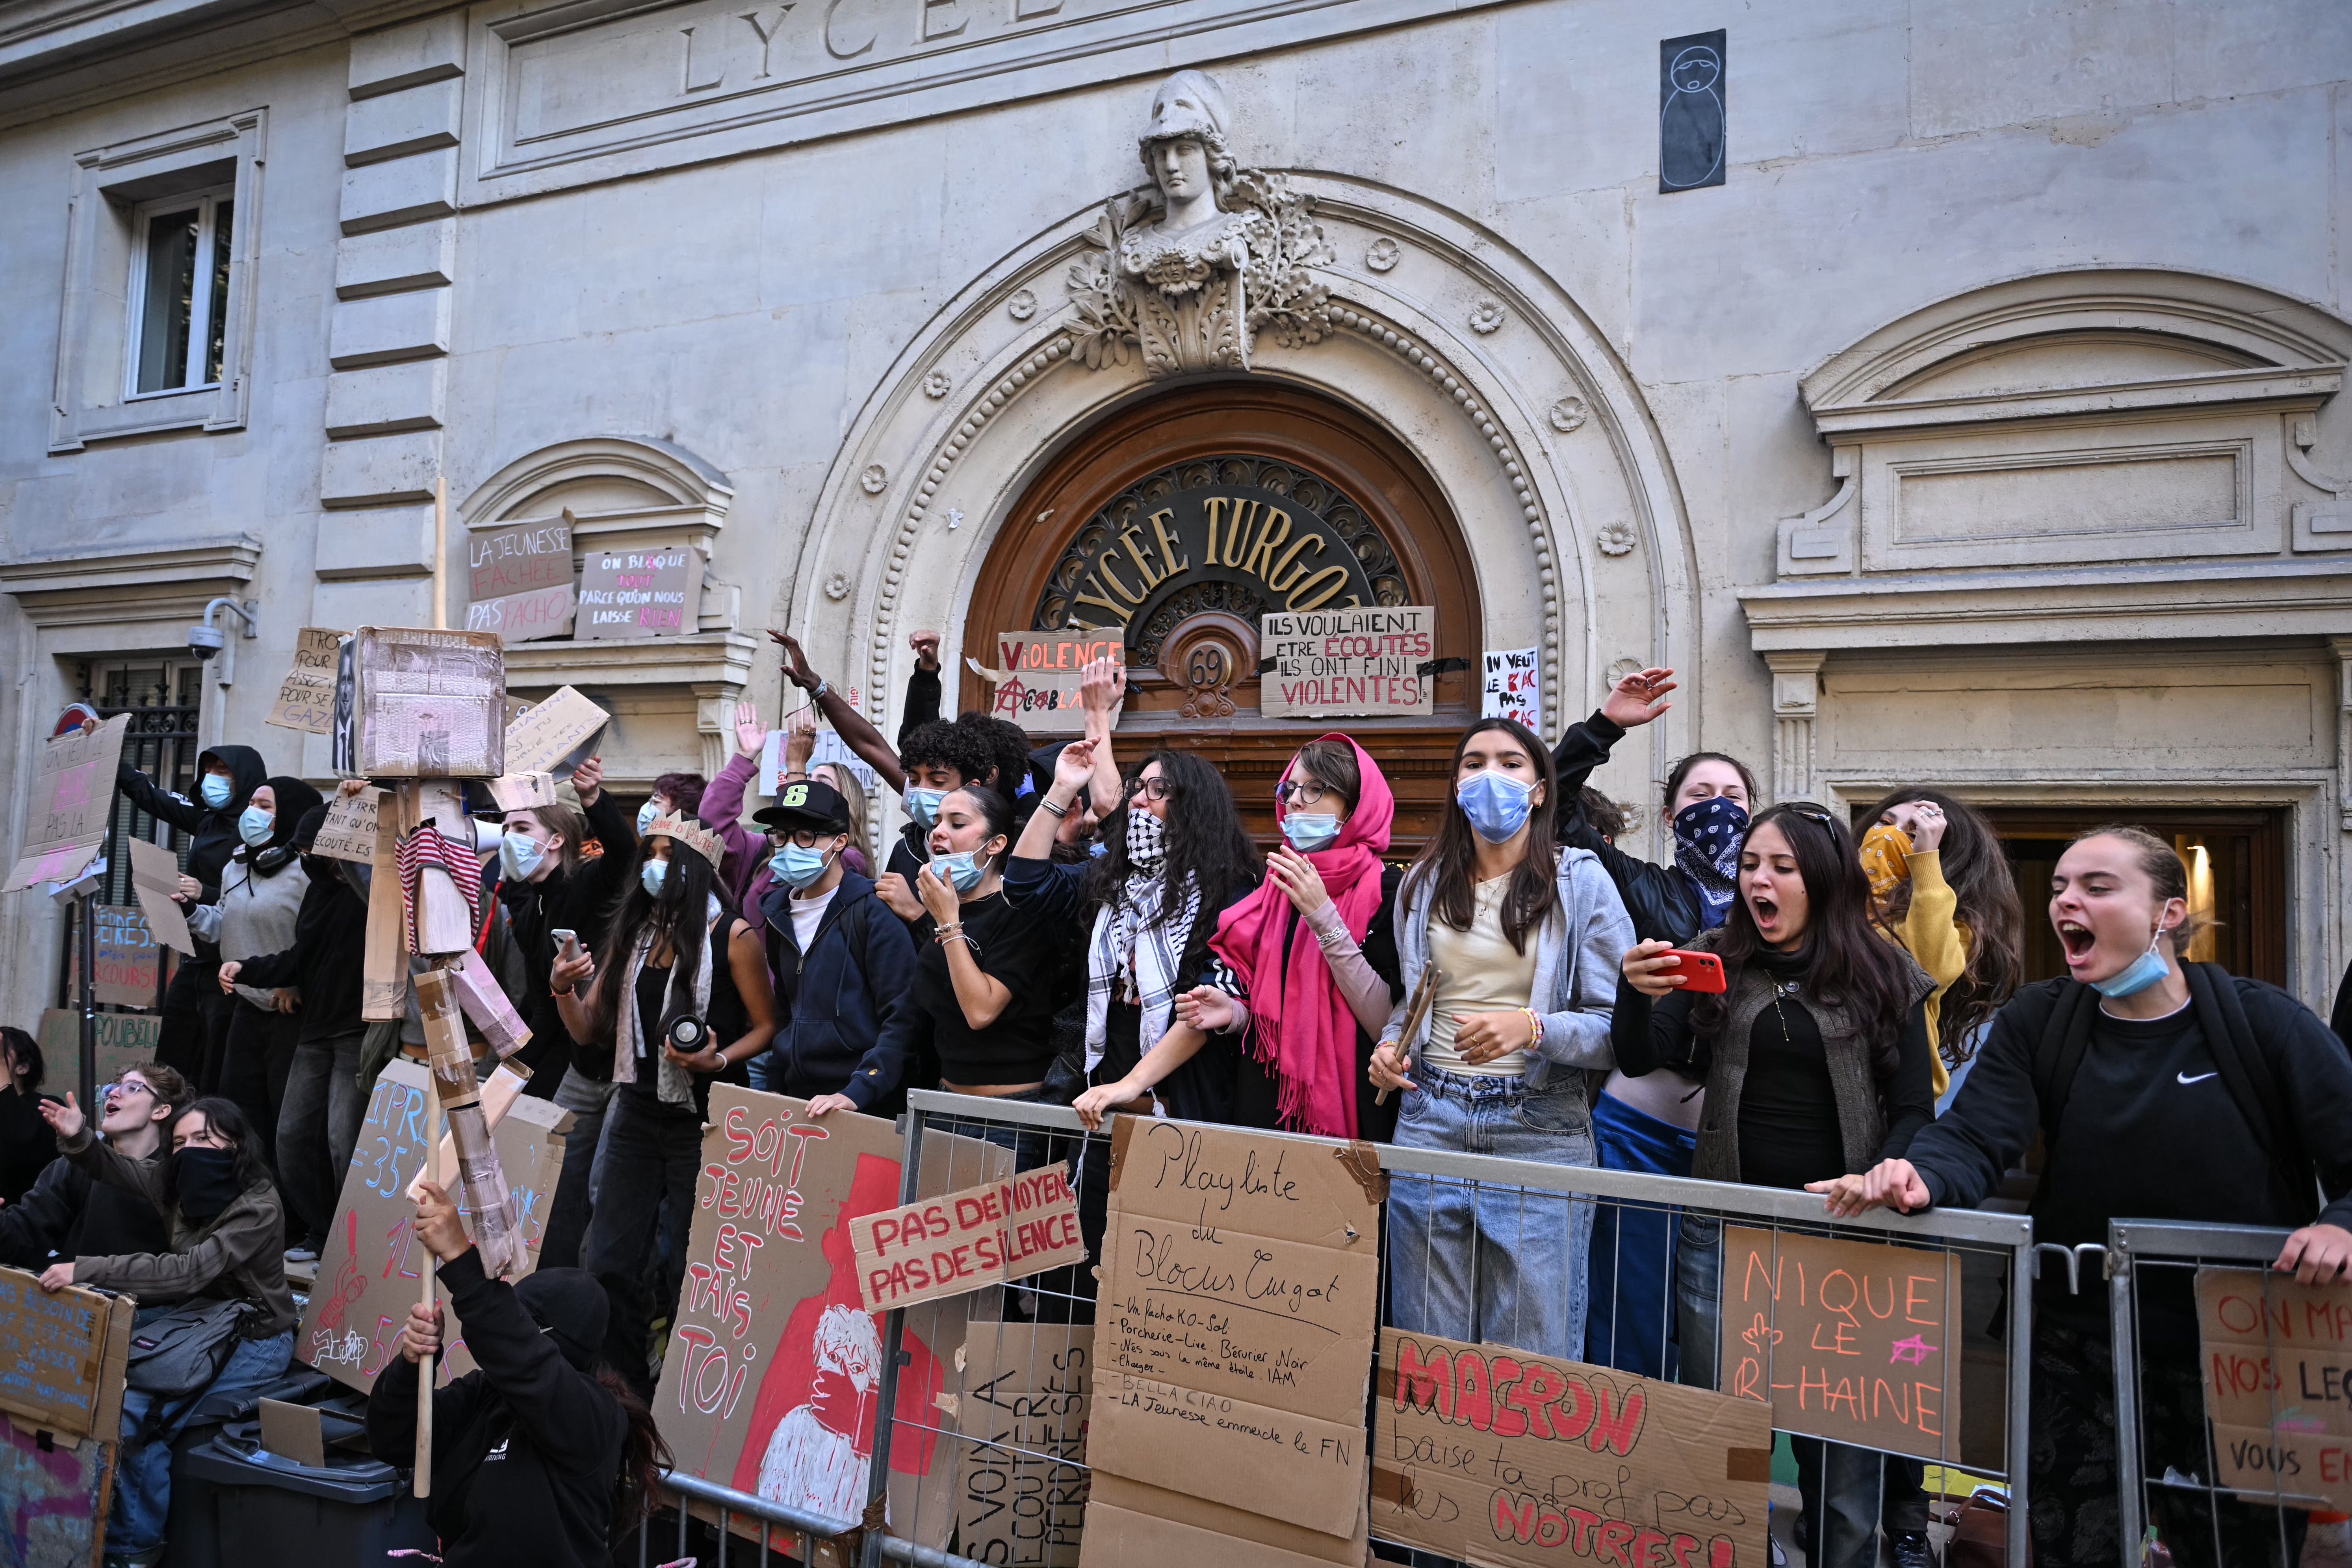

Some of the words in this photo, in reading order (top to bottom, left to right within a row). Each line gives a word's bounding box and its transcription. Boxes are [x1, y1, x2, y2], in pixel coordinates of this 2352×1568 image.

[470, 540, 493, 567] LA
[493, 526, 570, 559] JEUNESSE
[601, 558, 622, 570] ON
[1067, 507, 1189, 631] YCÉE
[1203, 497, 1361, 612] TURGO
[473, 555, 568, 595] FACHÉE
[616, 575, 655, 589] TOUT
[468, 599, 505, 631] PAS
[502, 592, 568, 631] FACHO
[579, 590, 615, 605] PARCE
[654, 591, 685, 603] NOUS
[592, 610, 634, 624] LAISSE
[638, 607, 683, 628] RIEN
[1269, 618, 1293, 636] ILS
[1297, 612, 1422, 636] VOULAIENT
[297, 649, 331, 669] POUR
[1276, 641, 1317, 657] ETRE
[1325, 628, 1431, 657] ÉCOUTÉS
[1506, 651, 1535, 669] VEUT
[286, 670, 329, 688] ASSEZ
[1190, 650, 1222, 685] 69
[1281, 659, 1301, 677] ILS
[1311, 657, 1352, 676] ONT
[1364, 657, 1407, 676] FINI
[1485, 679, 1500, 693] LE
[1508, 669, 1536, 692] BAC
[280, 687, 311, 704] POUR
[312, 693, 330, 707] SE
[1499, 692, 1526, 708] PAS
[534, 717, 551, 731] TU
[551, 722, 572, 739] TES
[782, 784, 809, 806] S
[45, 813, 66, 839] PAS
[70, 812, 83, 836] LA
[325, 813, 347, 826] TANT
[701, 1163, 804, 1242] JEUNE
[871, 1206, 951, 1257] PAS
[954, 1192, 1002, 1231] DE
[1192, 1198, 1223, 1245] du
[714, 1223, 763, 1281] ET
[1134, 1229, 1234, 1292] Blocus
[869, 1258, 932, 1304] PAS
[931, 1244, 975, 1285] DE
[1744, 1251, 1939, 1328] NIQUE
[1127, 1296, 1141, 1316] Un
[2218, 1295, 2293, 1339] ON
[1221, 1339, 1269, 1363] Bérurier
[1275, 1347, 1309, 1371] Noir
[1812, 1322, 1861, 1355] LE
[1120, 1338, 1143, 1354] Nés
[1150, 1348, 1171, 1358] sous
[1179, 1350, 1191, 1364] la
[1195, 1357, 1220, 1370] même
[1268, 1367, 1296, 1387] IAM
[2213, 1352, 2281, 1399] NOS
[972, 1369, 1016, 1410] A
[1123, 1373, 1178, 1402] BELLA
[1185, 1390, 1232, 1413] CIAO
[1392, 1337, 1647, 1457] MACRON
[1121, 1392, 1140, 1407] LA
[1143, 1396, 1210, 1427] Jeunesse
[1294, 1431, 1310, 1455] le
[1320, 1438, 1350, 1466] FN
[1393, 1418, 1478, 1475] baise
[1489, 1442, 1538, 1491] ta
[1543, 1464, 1635, 1523] prof
[1654, 1490, 1746, 1528] pas
[2230, 1439, 2302, 1476] VOUS
[967, 1431, 1010, 1527] VOIX
[1044, 1425, 1083, 1546] PERDRE
[1391, 1462, 1461, 1522] les
